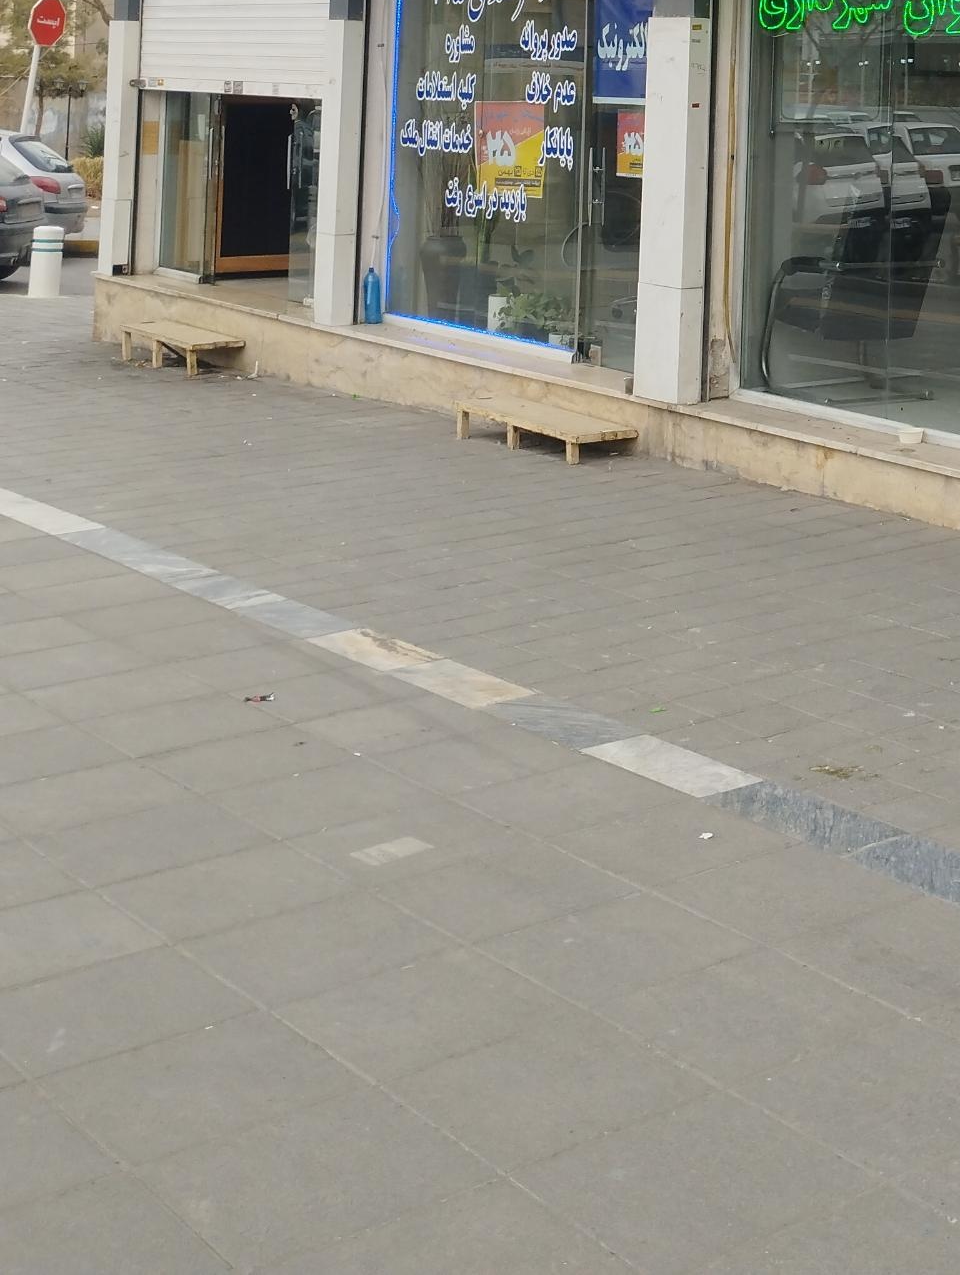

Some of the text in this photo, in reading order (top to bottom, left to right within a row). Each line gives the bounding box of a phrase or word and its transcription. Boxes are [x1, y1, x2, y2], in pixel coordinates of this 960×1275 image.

[36, 15, 60, 29] ایست
[519, 20, 578, 63] صدور پروانه
[444, 24, 476, 63] مشاوره
[416, 71, 477, 110] کلیه استعلامات
[525, 71, 576, 113] عدم خلاف
[400, 118, 420, 147] ملک
[442, 122, 474, 154] خدمات
[538, 126, 574, 171] پایانکار
[444, 177, 528, 223] بازدید در اسرع وقت
